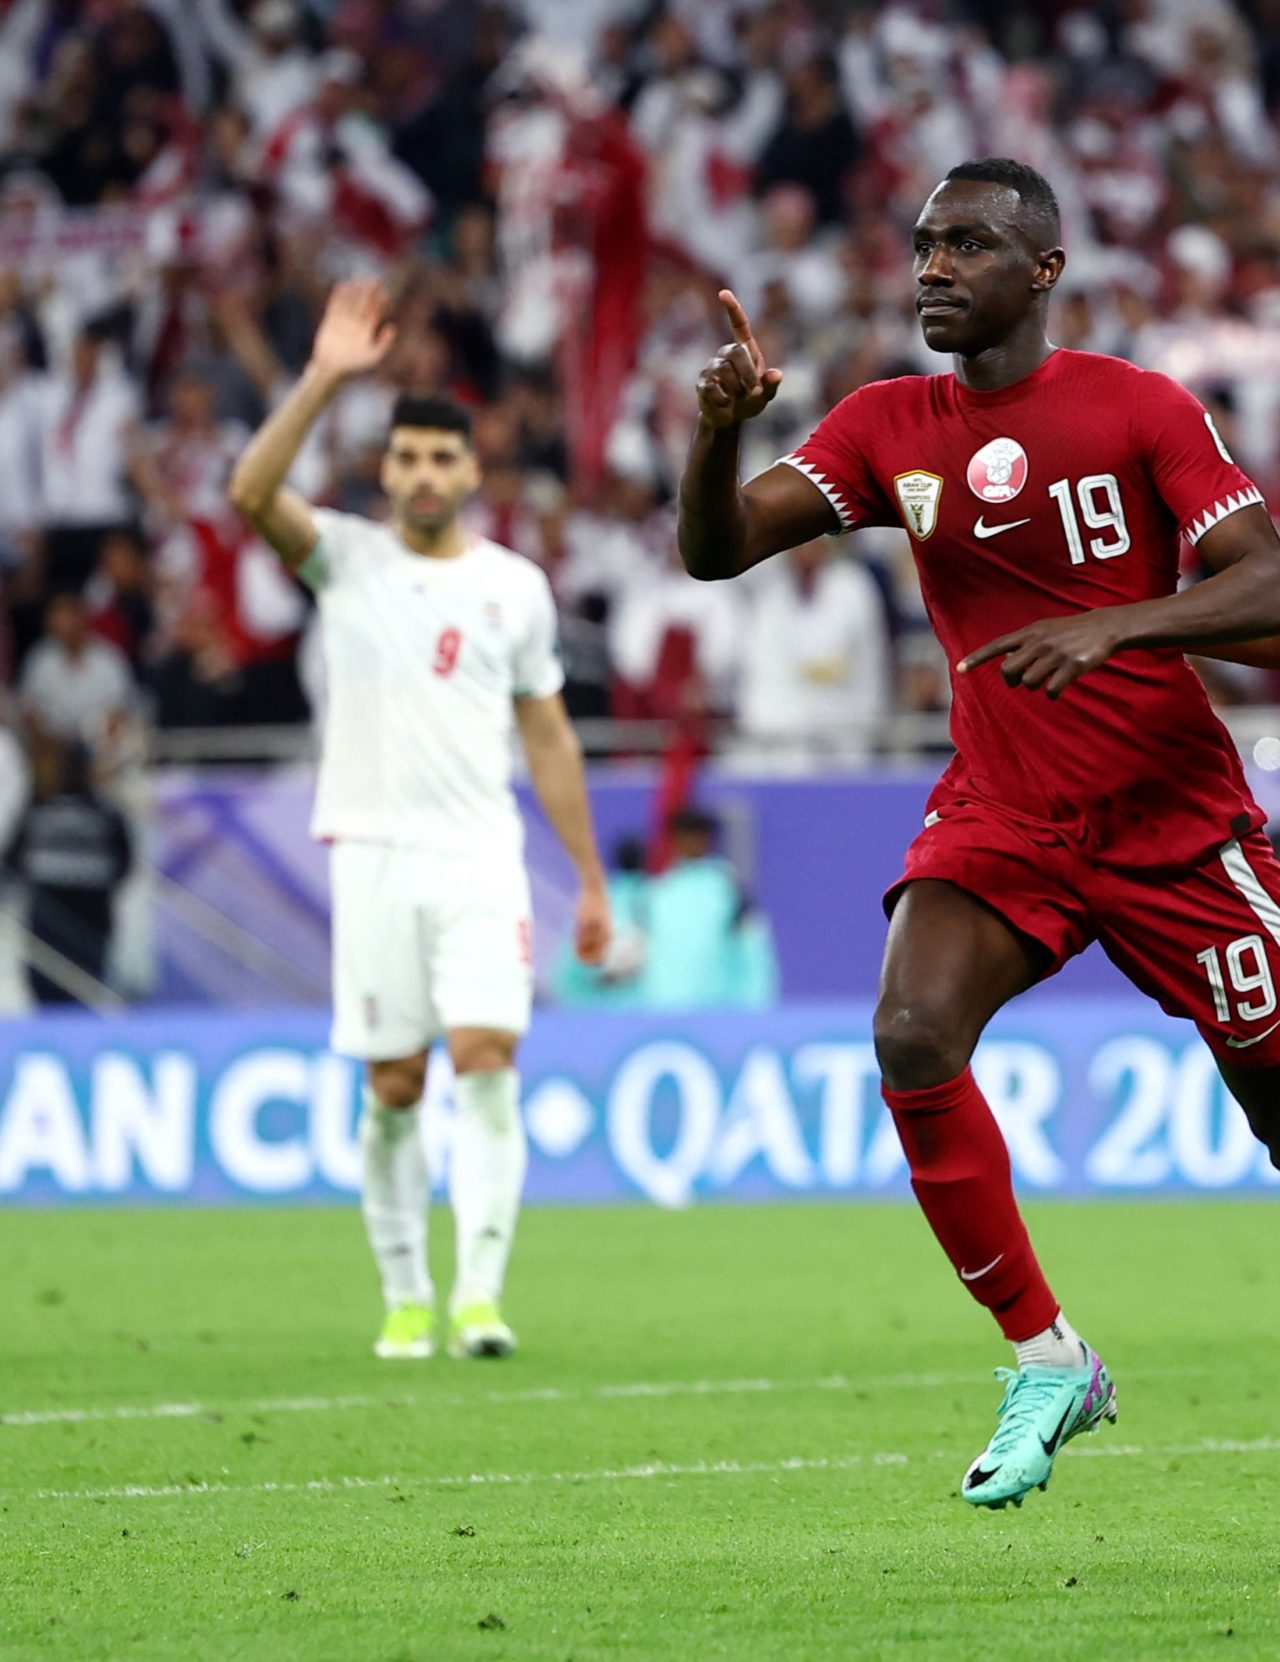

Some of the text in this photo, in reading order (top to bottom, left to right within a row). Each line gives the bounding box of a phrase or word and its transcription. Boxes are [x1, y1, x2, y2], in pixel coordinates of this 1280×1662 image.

[1048, 473, 1131, 565] 19
[432, 627, 461, 678] 9
[1196, 934, 1278, 1022] 19
[0, 1050, 196, 1192] AN
[606, 1038, 1067, 1208] QATR
